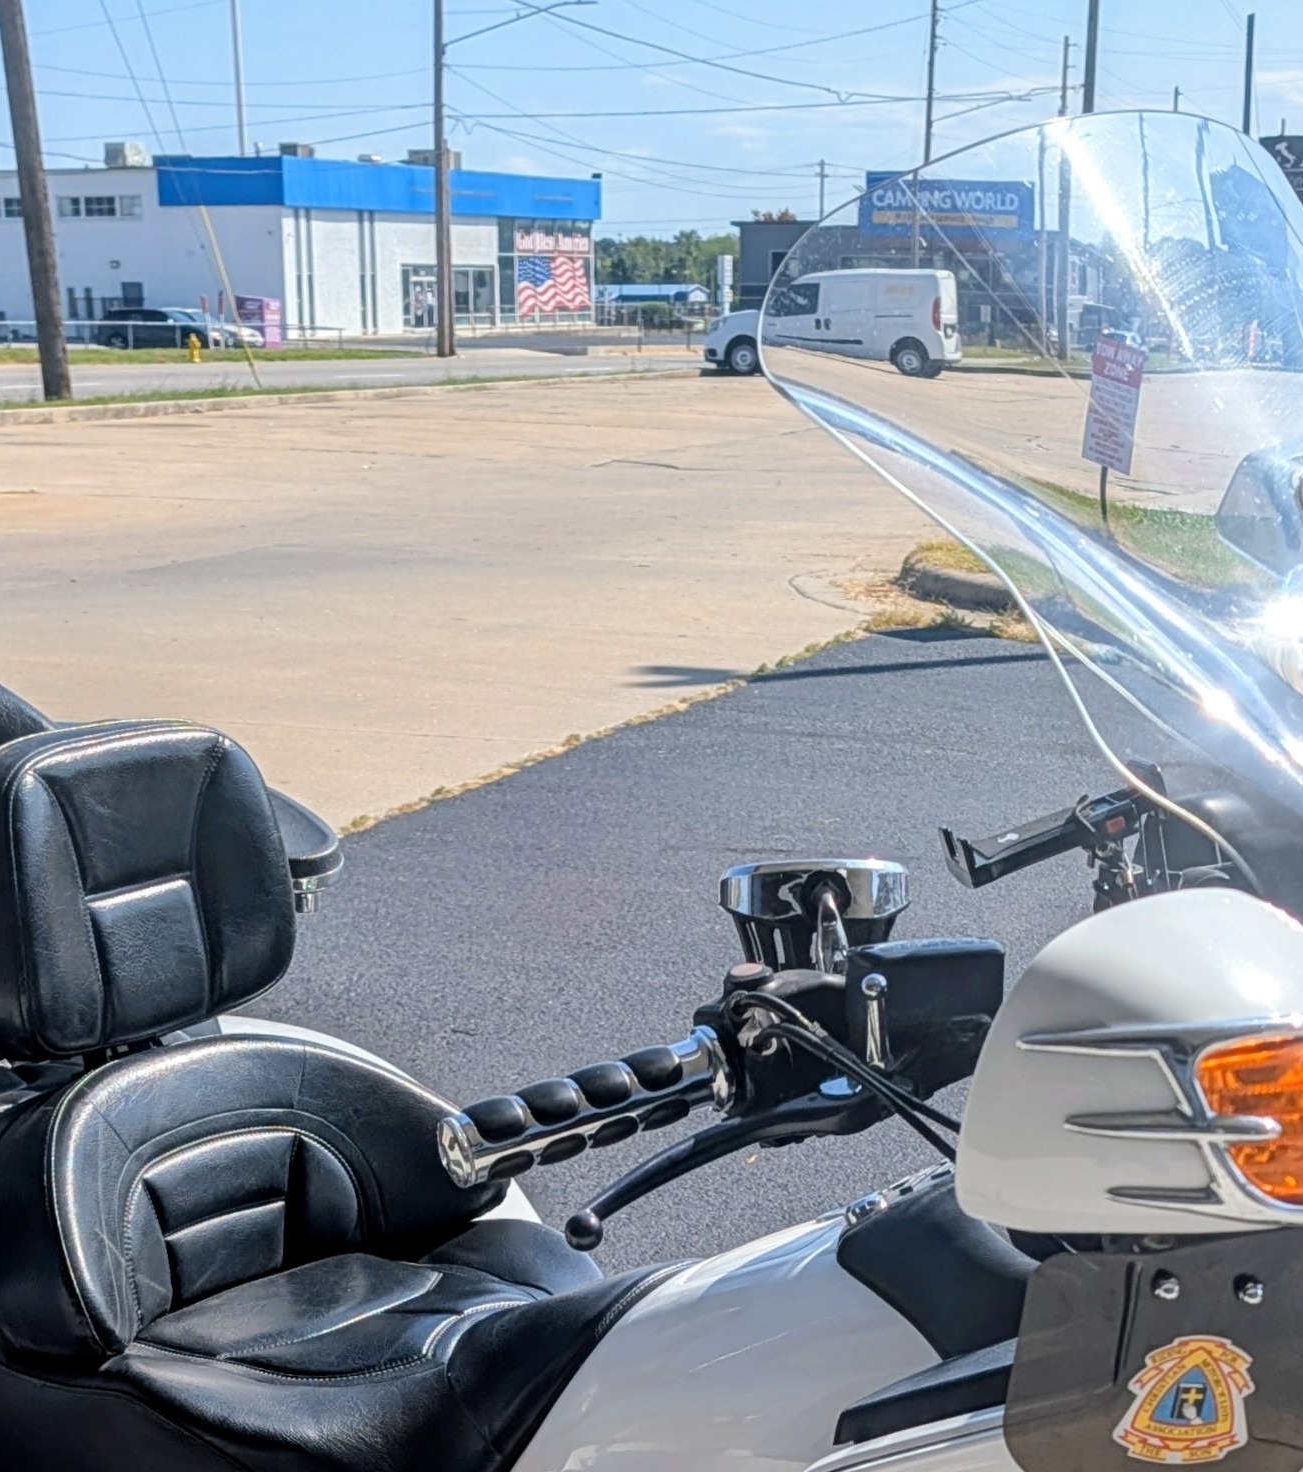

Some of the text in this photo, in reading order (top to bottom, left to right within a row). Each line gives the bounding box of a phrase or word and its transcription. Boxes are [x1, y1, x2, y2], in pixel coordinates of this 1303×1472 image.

[872, 189, 1020, 211] CAMING WORLD
[1096, 341, 1144, 370] TOW AWAY
[1104, 361, 1129, 381] ZONE
